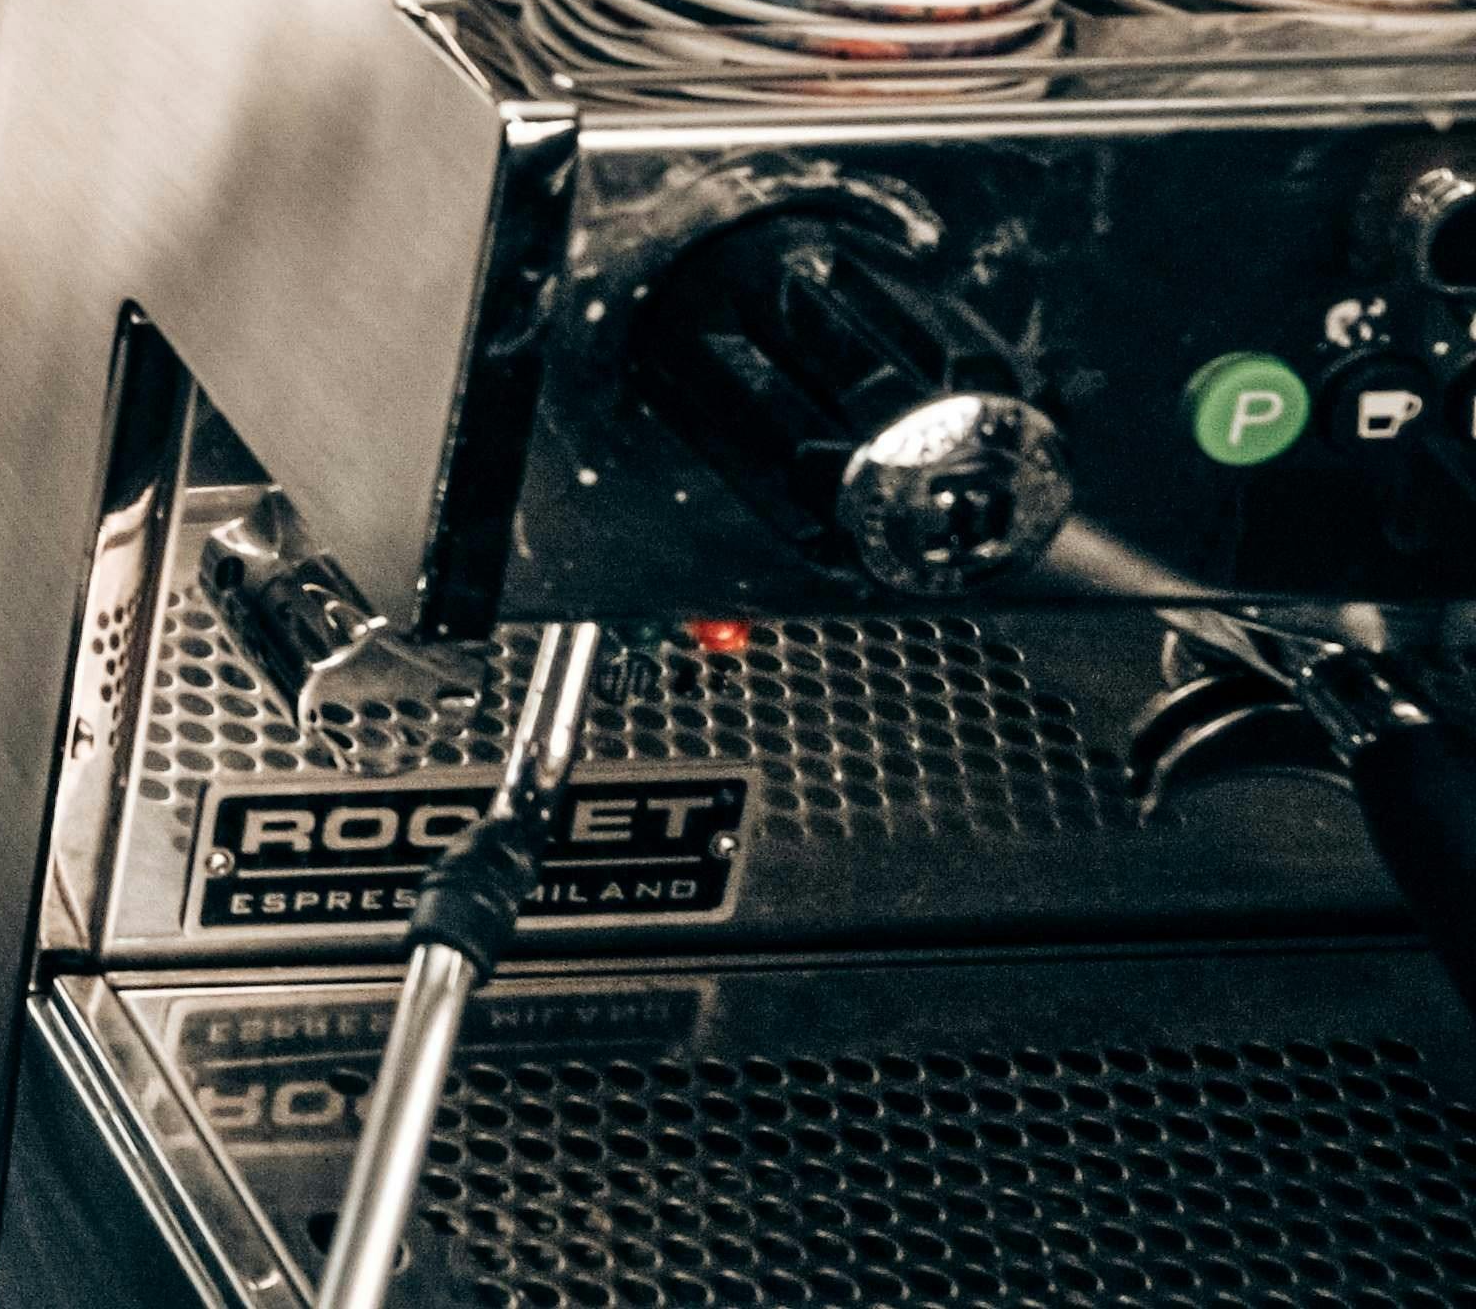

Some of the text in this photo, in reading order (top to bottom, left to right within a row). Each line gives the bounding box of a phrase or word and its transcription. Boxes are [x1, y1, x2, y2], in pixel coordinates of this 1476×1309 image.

[1229, 390, 1284, 446] P
[240, 795, 714, 855] ROCET
[230, 886, 420, 915] ESPRES
